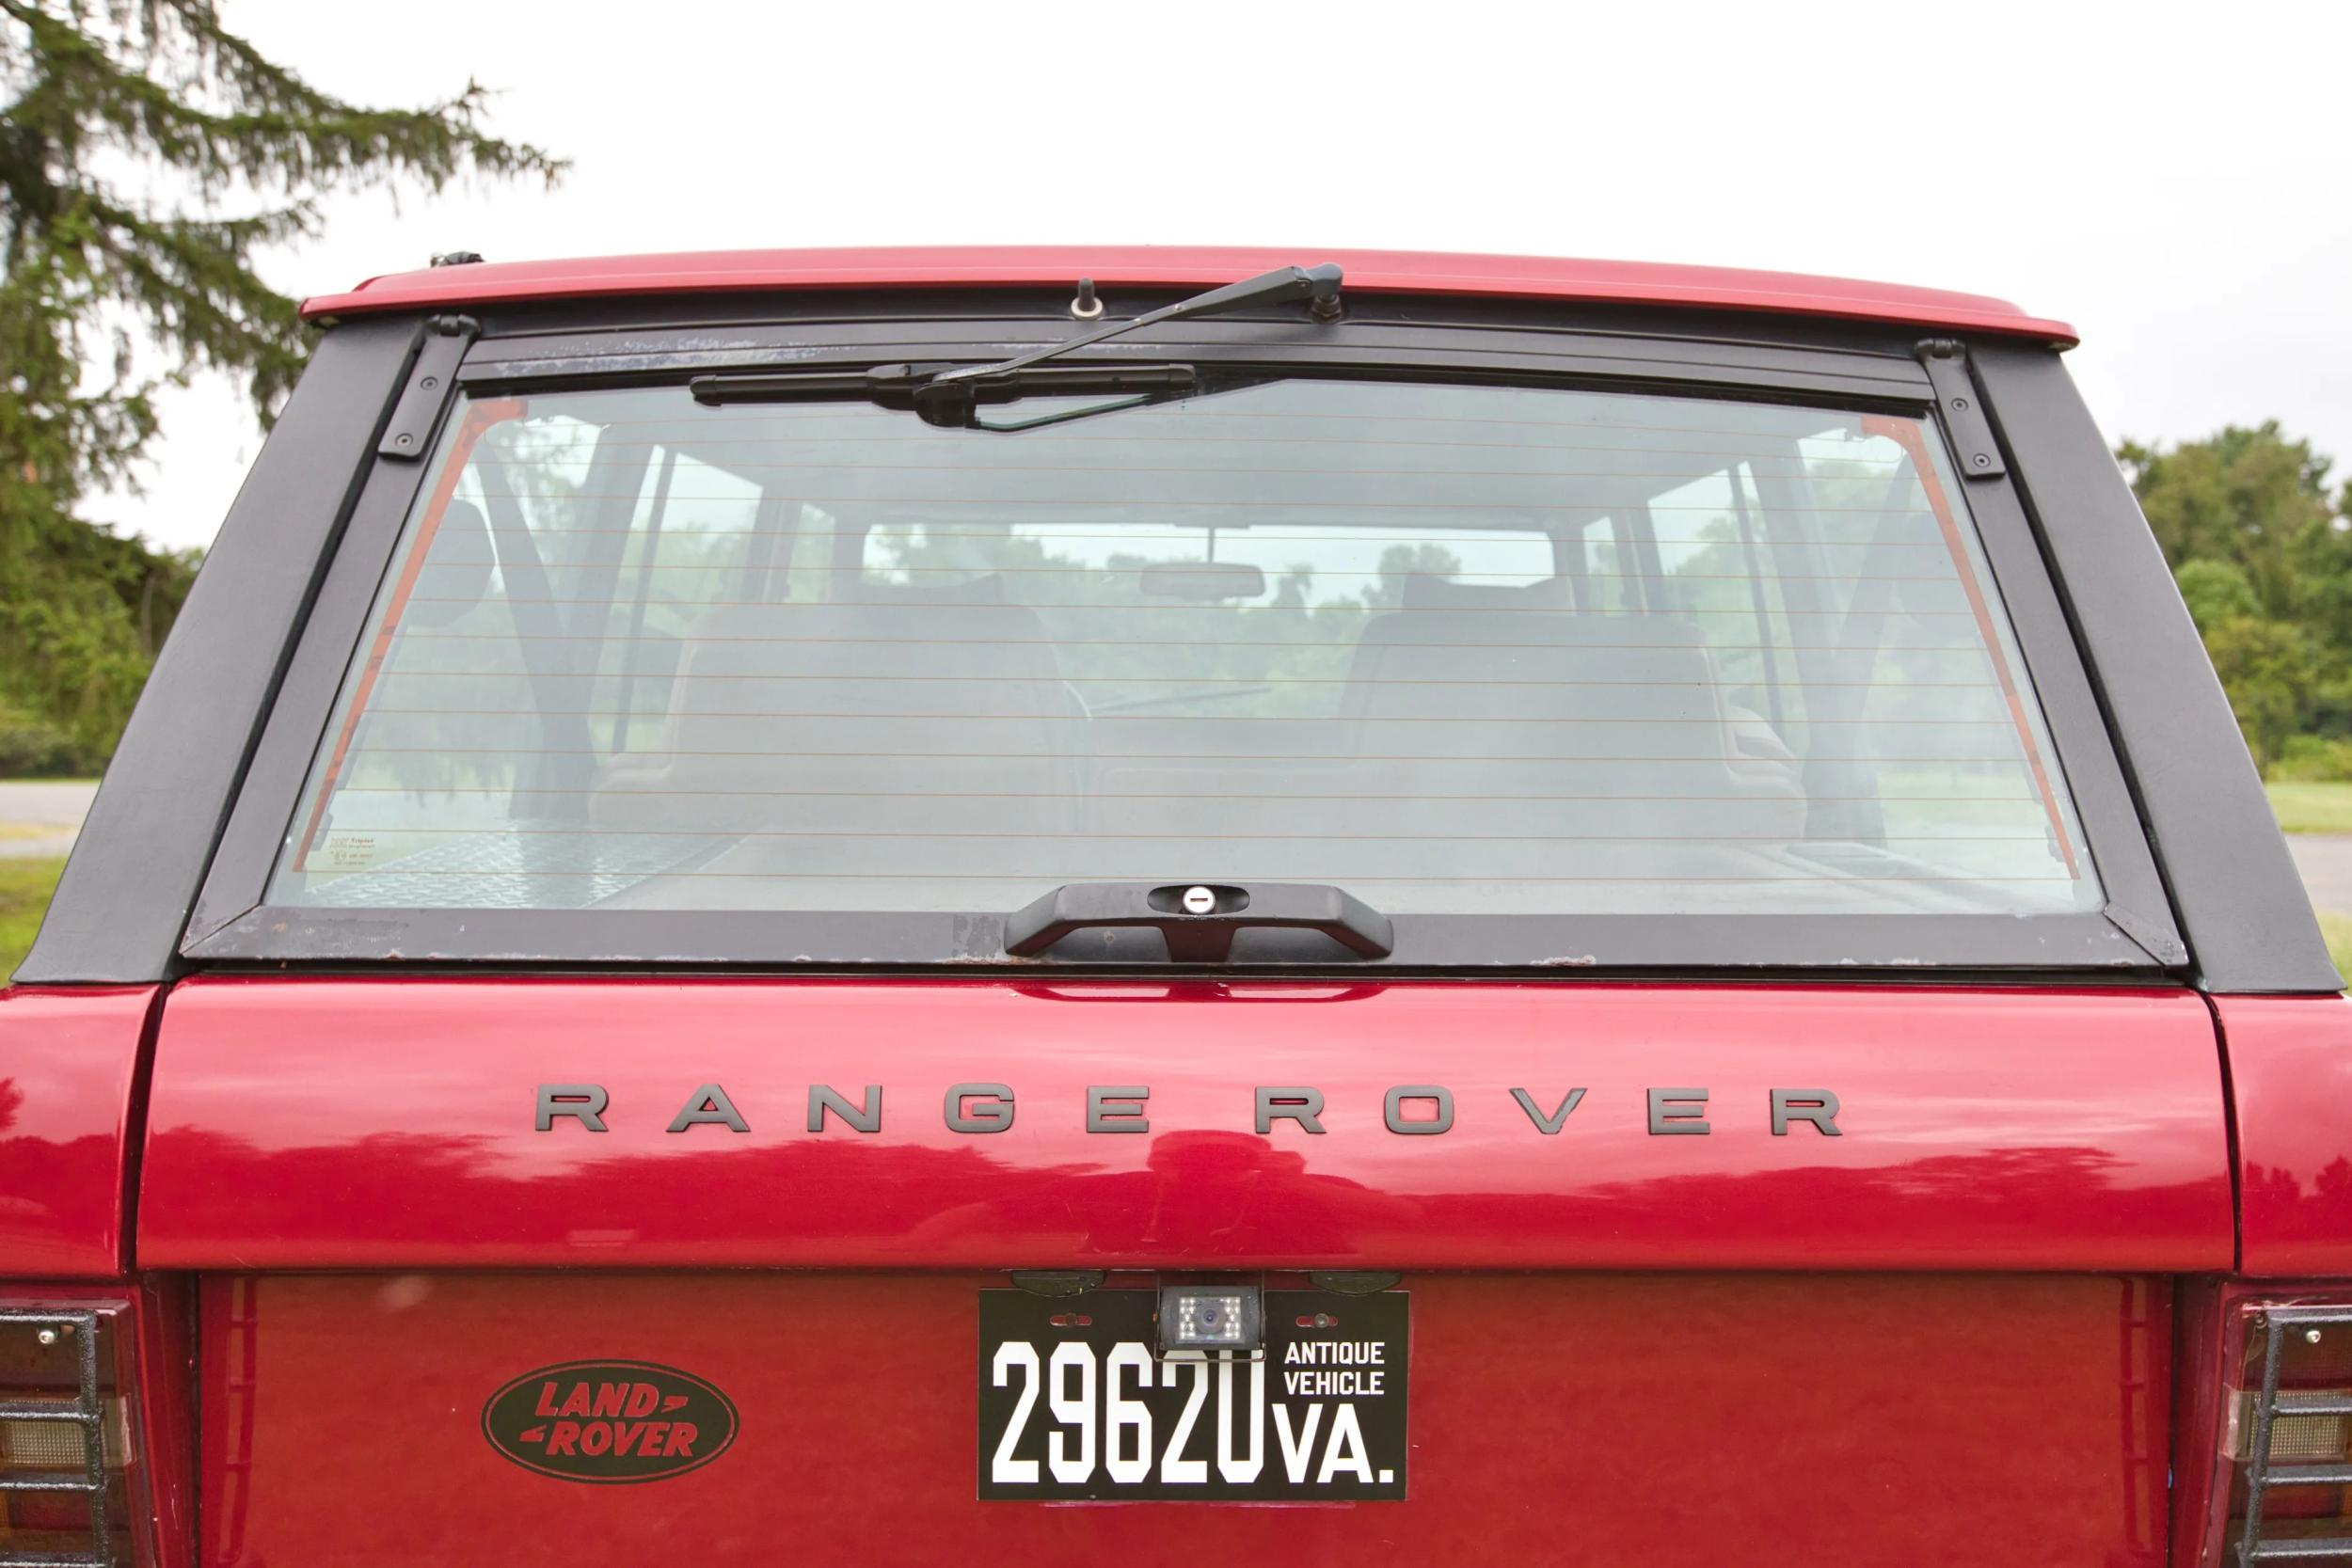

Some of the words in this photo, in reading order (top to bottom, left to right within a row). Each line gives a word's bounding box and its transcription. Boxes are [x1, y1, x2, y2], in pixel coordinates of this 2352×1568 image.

[535, 1083, 1150, 1133] RANGE
[1254, 1085, 1843, 1137] ROVER
[1284, 1341, 1385, 1365] ANTIQUE
[534, 1382, 660, 1418] LAND
[1284, 1371, 1385, 1395] VEHICLE
[545, 1421, 698, 1457] ROVER
